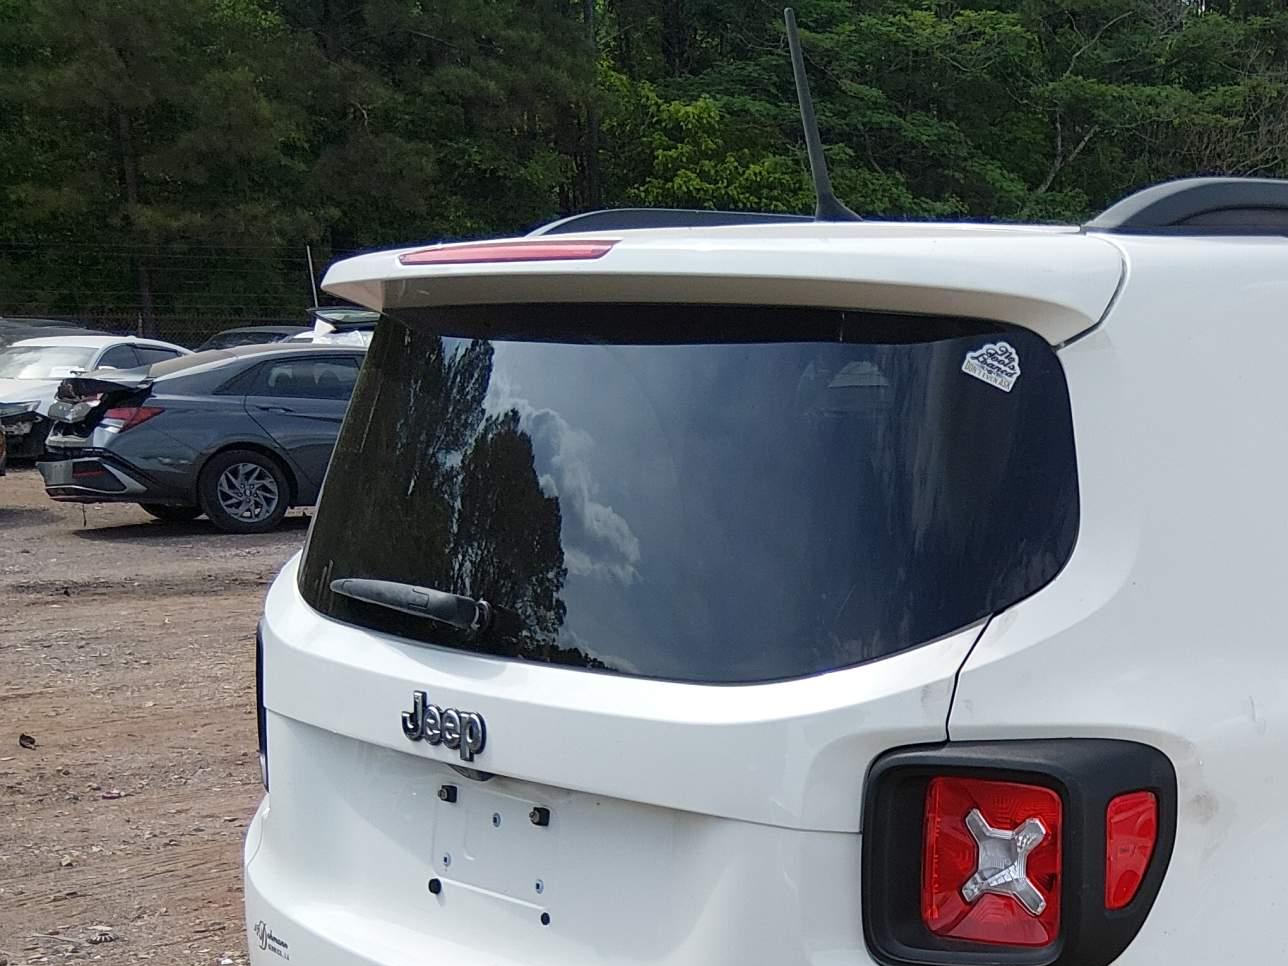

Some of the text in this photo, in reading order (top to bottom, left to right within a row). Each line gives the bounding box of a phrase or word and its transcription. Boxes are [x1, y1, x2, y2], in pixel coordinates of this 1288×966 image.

[969, 352, 1018, 378] Loaned
[986, 347, 1017, 371] Tools
[401, 690, 487, 762] Jeep
